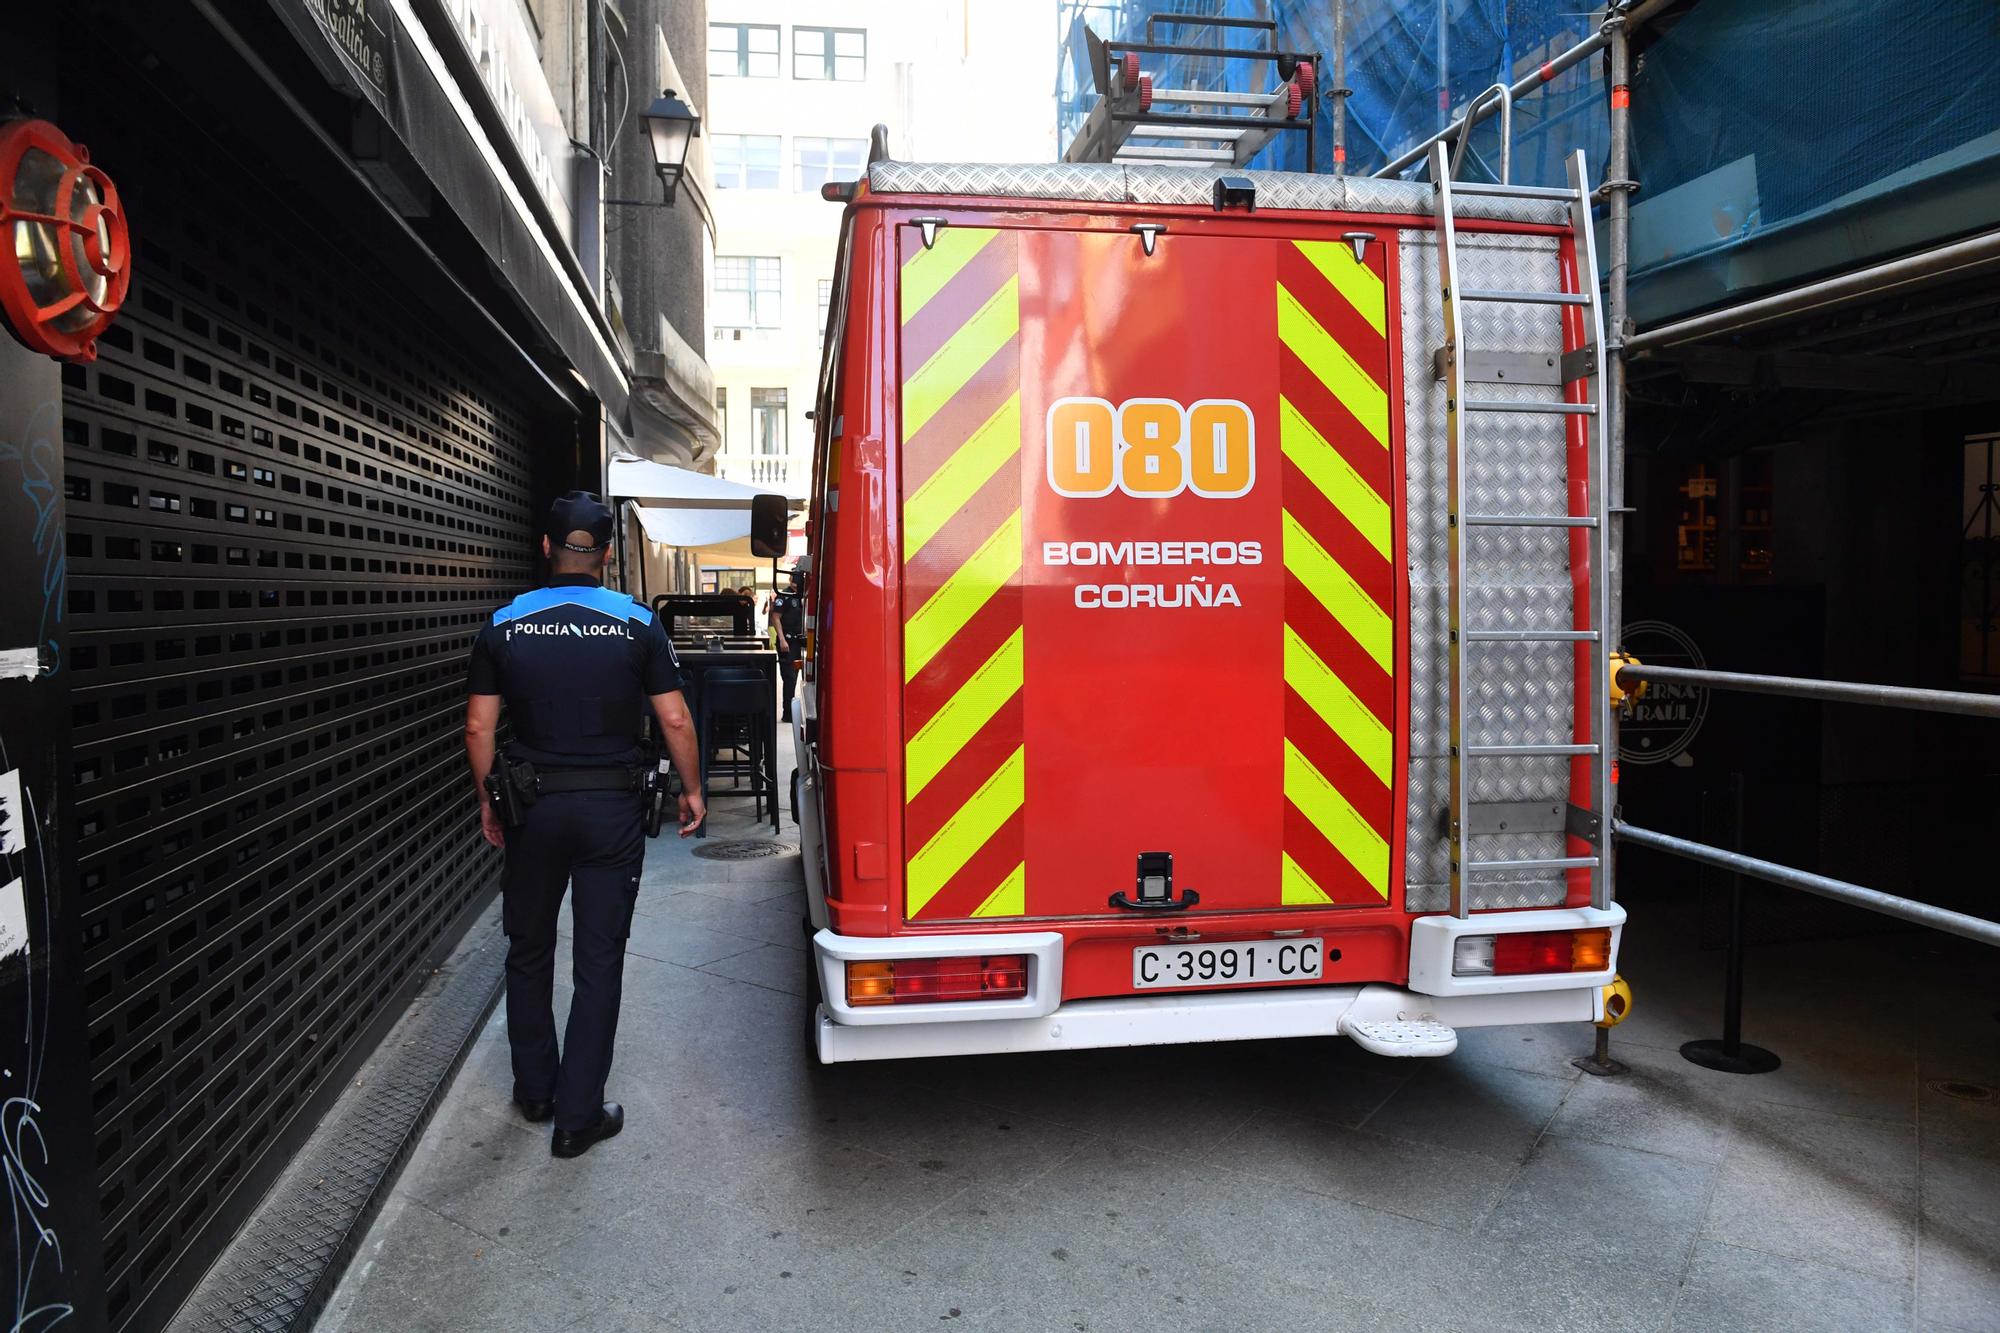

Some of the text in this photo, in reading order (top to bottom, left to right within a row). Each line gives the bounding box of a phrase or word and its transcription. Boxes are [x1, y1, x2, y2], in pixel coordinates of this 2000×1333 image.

[327, 0, 370, 72] Galicia
[1046, 396, 1256, 499] 080
[1043, 541, 1263, 566] BOMBEROS
[1074, 575, 1242, 608] CORUÑA
[514, 622, 570, 636] POLICÍA
[583, 624, 625, 636] LOCAL
[1640, 683, 1698, 699] ERNA
[1636, 700, 1690, 721] RAÚL
